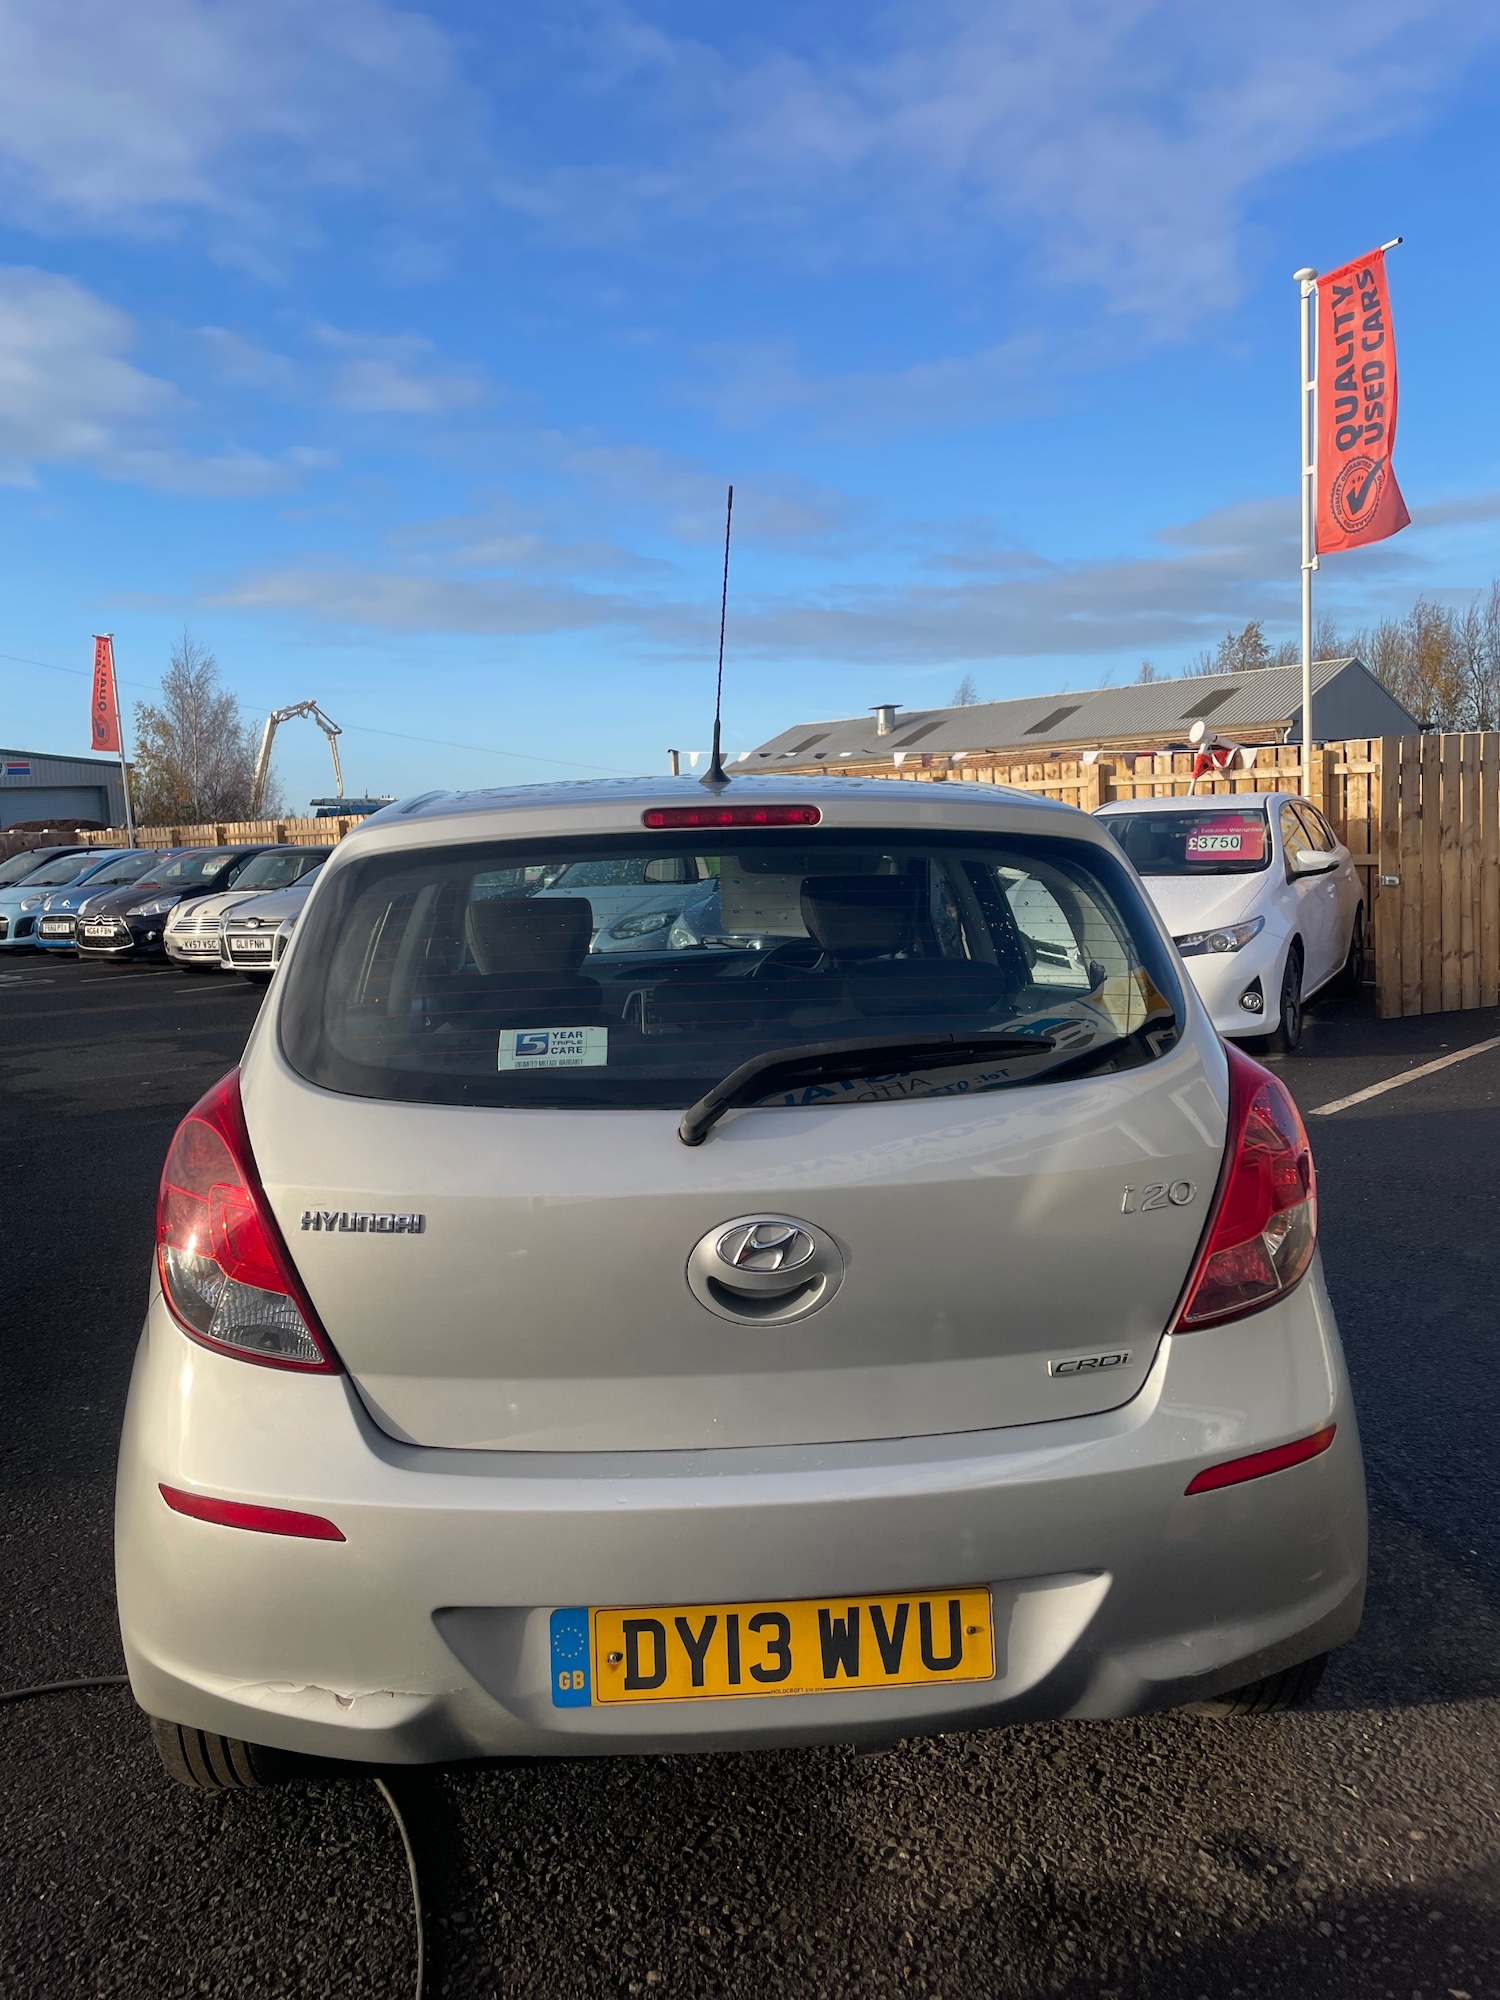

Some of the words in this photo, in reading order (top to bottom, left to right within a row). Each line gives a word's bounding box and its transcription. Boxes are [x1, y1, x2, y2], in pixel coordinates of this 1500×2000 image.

[1356, 268, 1385, 352] CARS
[1331, 285, 1364, 451] QUALITY
[1361, 360, 1385, 446] USED
[1188, 837, 1239, 850] £3750
[185, 941, 200, 949] KV57
[250, 940, 264, 949] FNH
[552, 1031, 583, 1039] YEAR
[551, 1047, 583, 1055] CARE
[1120, 1179, 1197, 1214] i20
[301, 1211, 425, 1234] HYUNDAI
[1055, 1353, 1129, 1373] CRDi
[623, 1612, 792, 1690] DY13
[818, 1600, 962, 1679] WVU
[558, 1671, 585, 1690] GB
